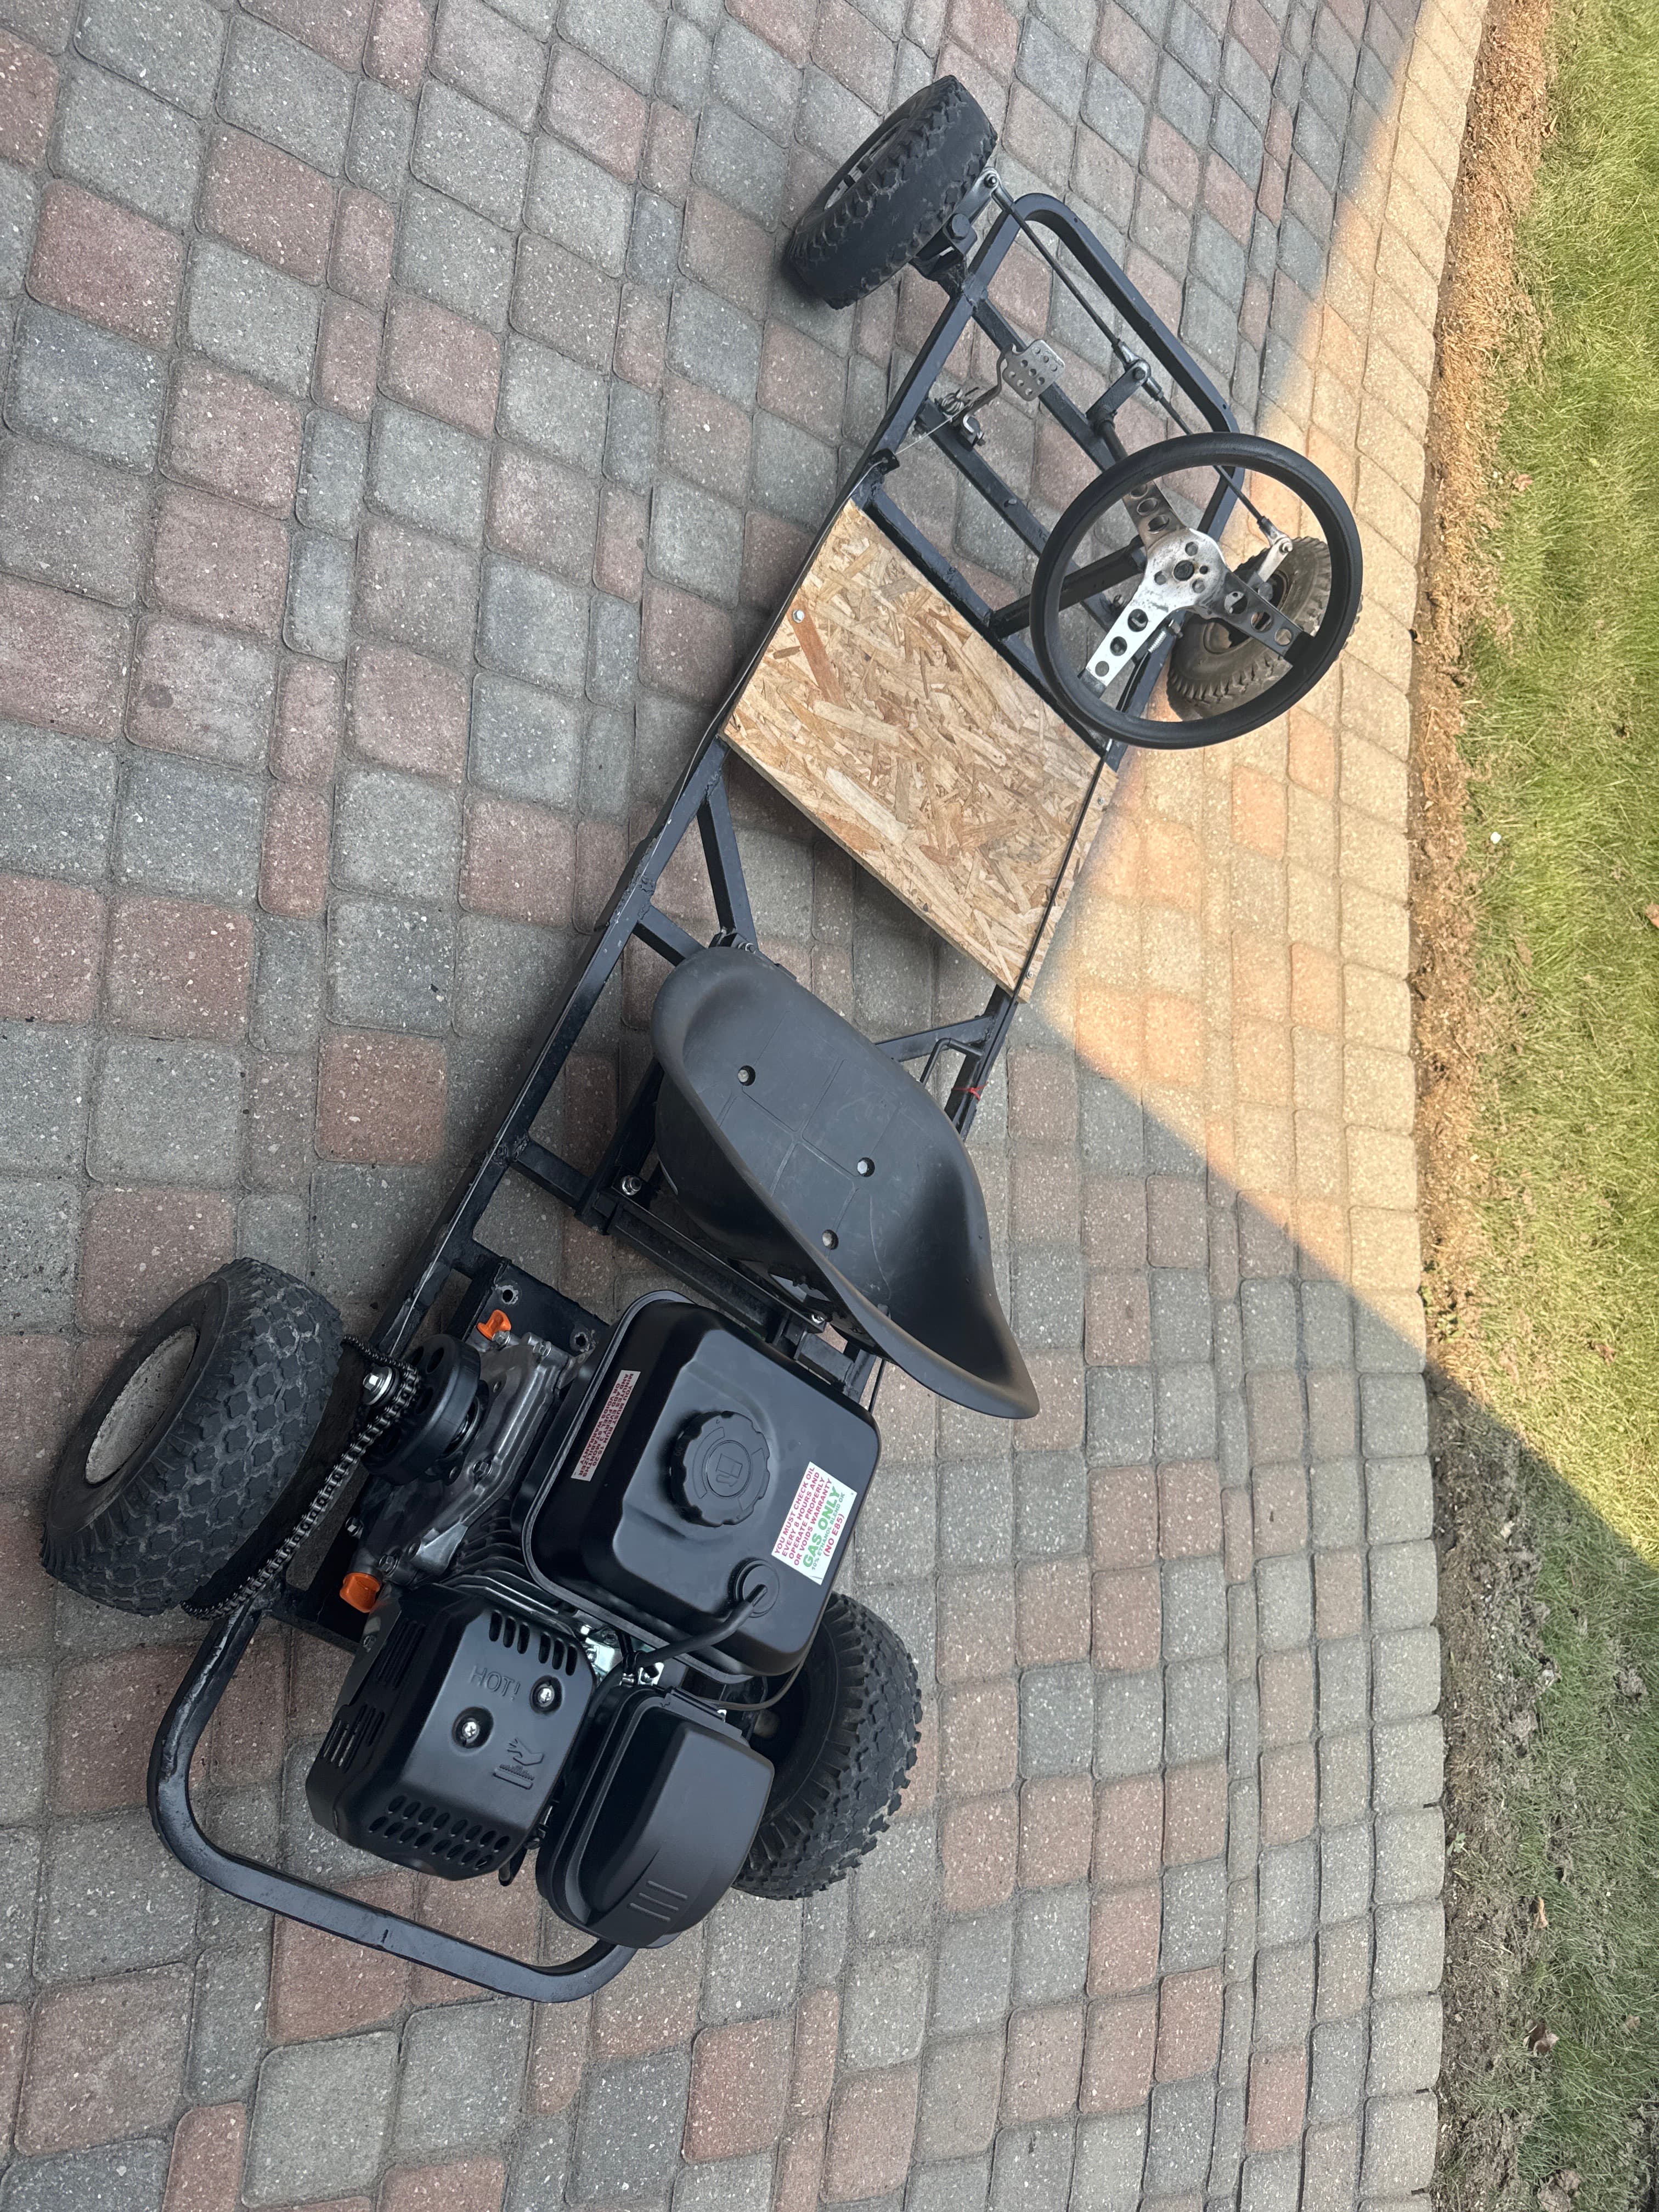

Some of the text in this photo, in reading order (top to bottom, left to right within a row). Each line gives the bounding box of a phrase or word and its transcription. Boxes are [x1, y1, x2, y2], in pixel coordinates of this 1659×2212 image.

[611, 1402, 624, 1425] MUST
[614, 1373, 634, 1407] MINUTES
[622, 1385, 633, 1401] YOU
[578, 1374, 629, 1476] AND ADD FUEL STABILIZER
[579, 1383, 620, 1465] OR VOIDS WARRANTY
[602, 1409, 617, 1434] EVERY
[602, 1426, 613, 1443] RUN
[582, 1443, 601, 1477] MONTHS
[774, 1466, 815, 1554] YOU MUST CHECK OIL
[781, 1527, 797, 1557] EVERY
[796, 1490, 812, 1521] HOURS
[809, 1471, 820, 1490] AND
[788, 1476, 825, 1559] OPERATE PROPERLY
[793, 1478, 832, 1566] OR VOIDS WARRANTY
[802, 1485, 840, 1568] GAS ONLY
[811, 1492, 845, 1571] 10% ETHANOL BLEND OK
[822, 1512, 845, 1557] (NO E85)
[469, 1666, 521, 1702] HOT!
